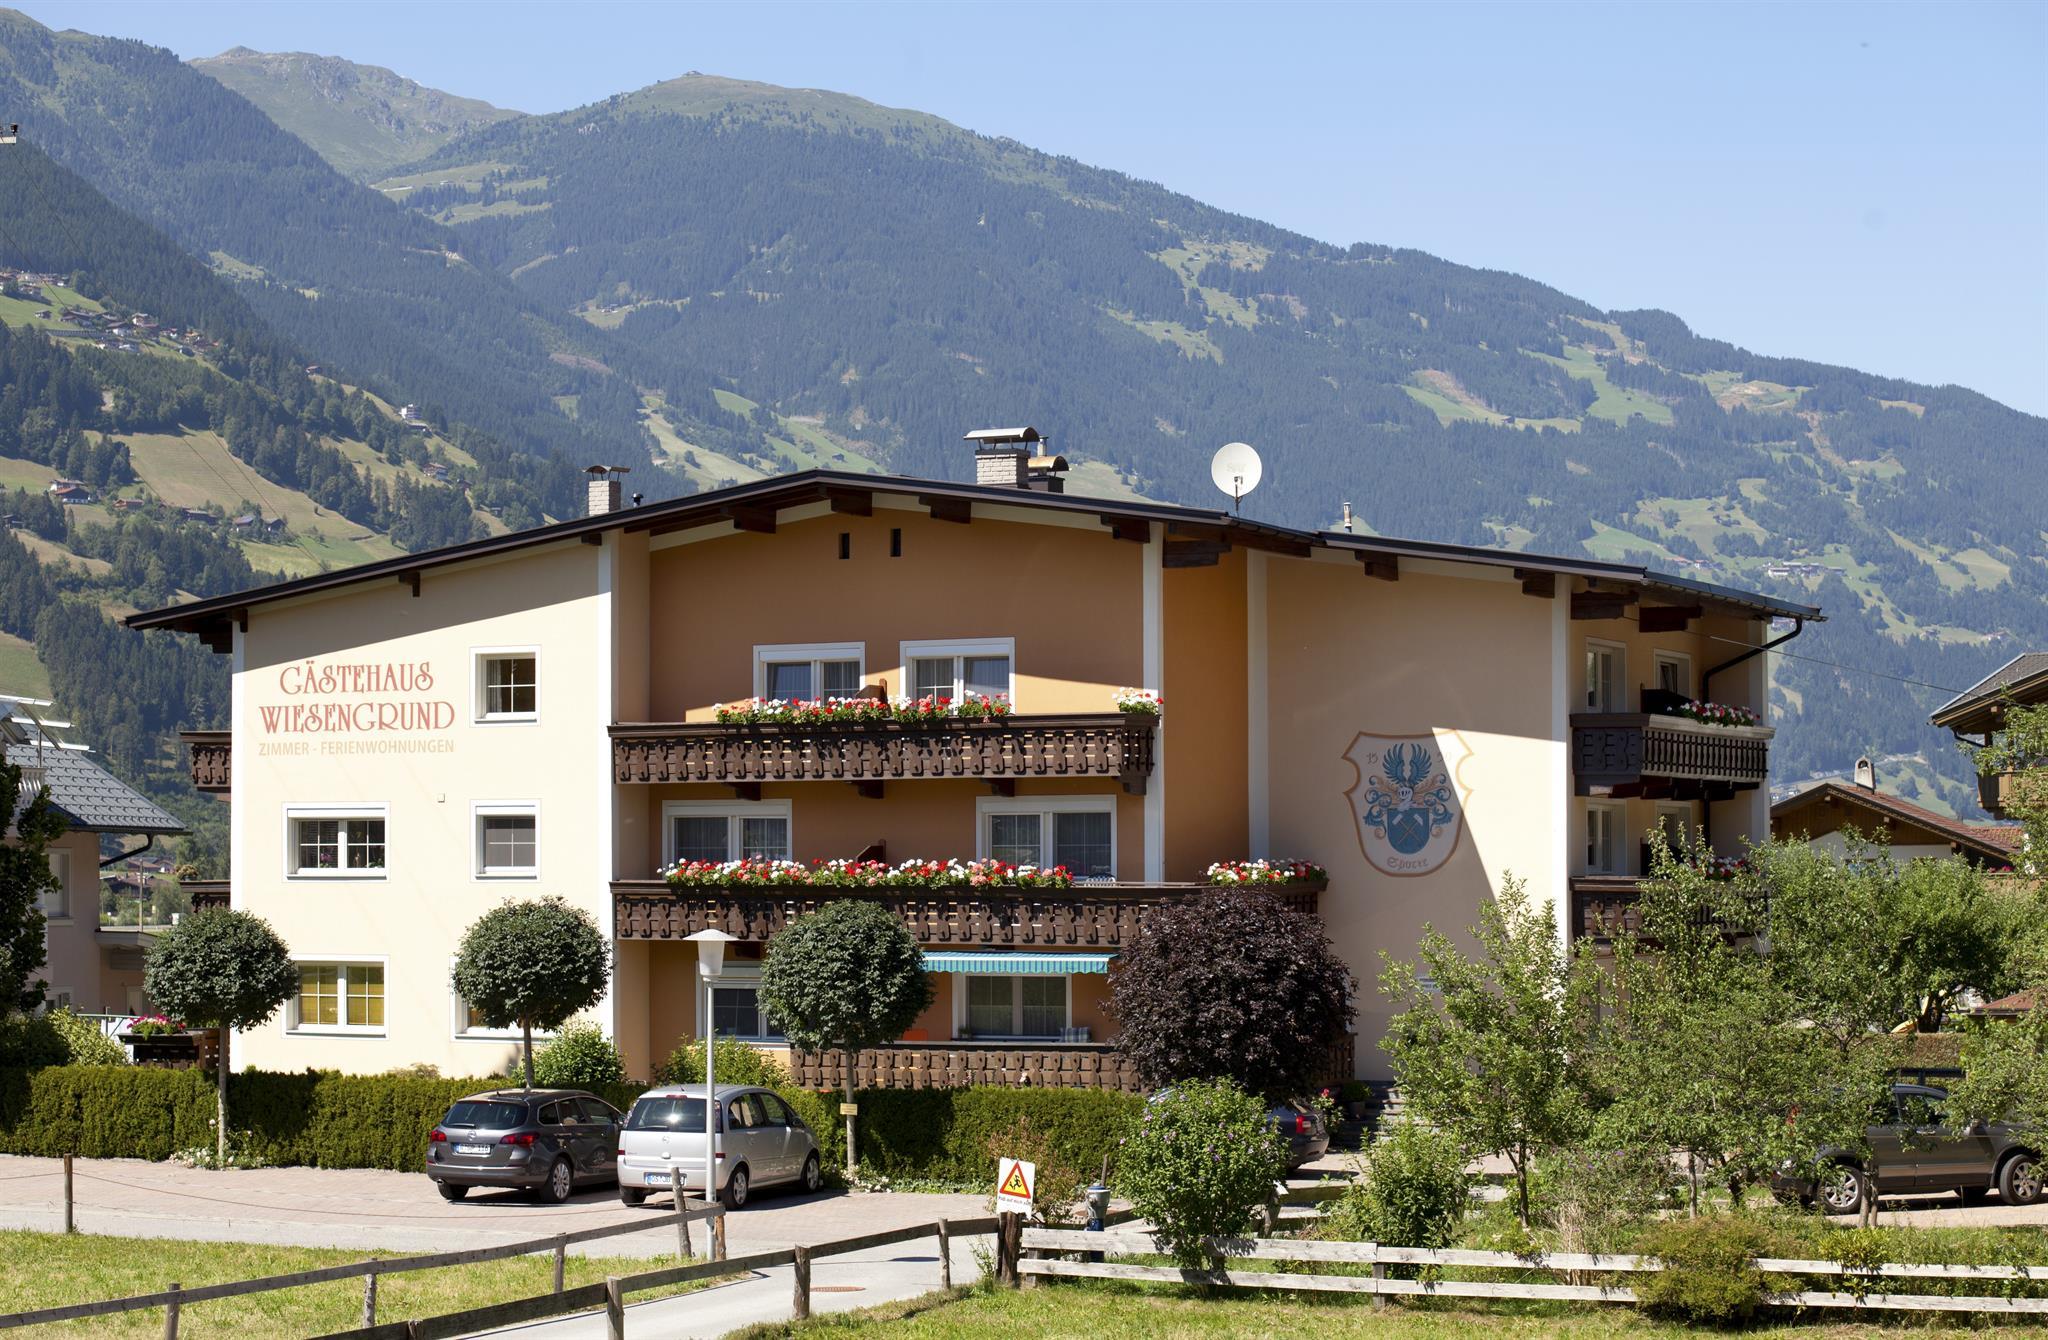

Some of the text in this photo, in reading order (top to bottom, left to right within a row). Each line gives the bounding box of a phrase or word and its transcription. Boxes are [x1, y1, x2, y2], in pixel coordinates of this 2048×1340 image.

[279, 660, 434, 695] GÄSTEHAUS
[258, 701, 455, 734] WIESENGRUND
[258, 742, 310, 756] ZIMMER
[320, 739, 455, 755] FERIENWOHNUNGEN
